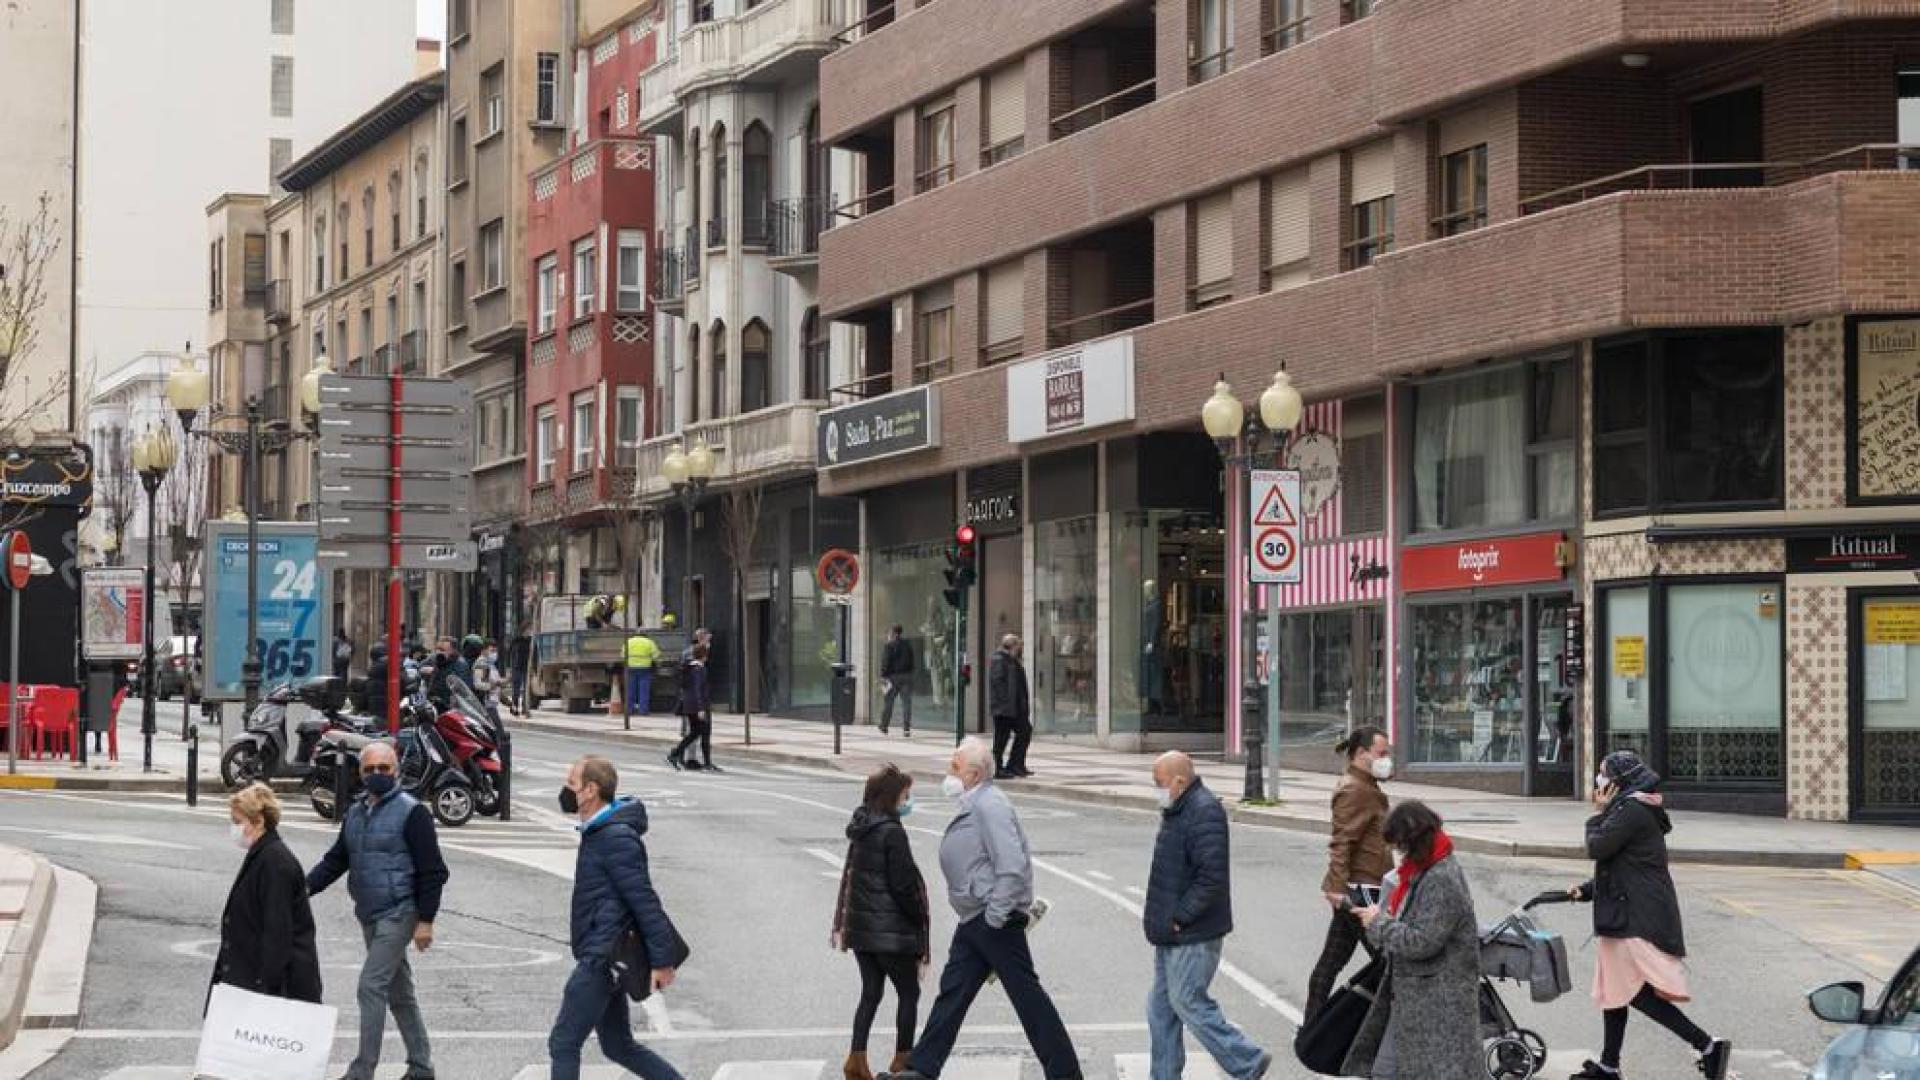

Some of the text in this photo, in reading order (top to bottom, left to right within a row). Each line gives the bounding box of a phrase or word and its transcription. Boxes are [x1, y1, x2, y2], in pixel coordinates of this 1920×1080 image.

[1264, 543, 1287, 557] 30
[1831, 533, 1896, 556] Ritual
[1458, 545, 1500, 572] fotoprix
[270, 560, 316, 599] 24
[292, 601, 316, 638] 7
[235, 1028, 304, 1053] MANGO
